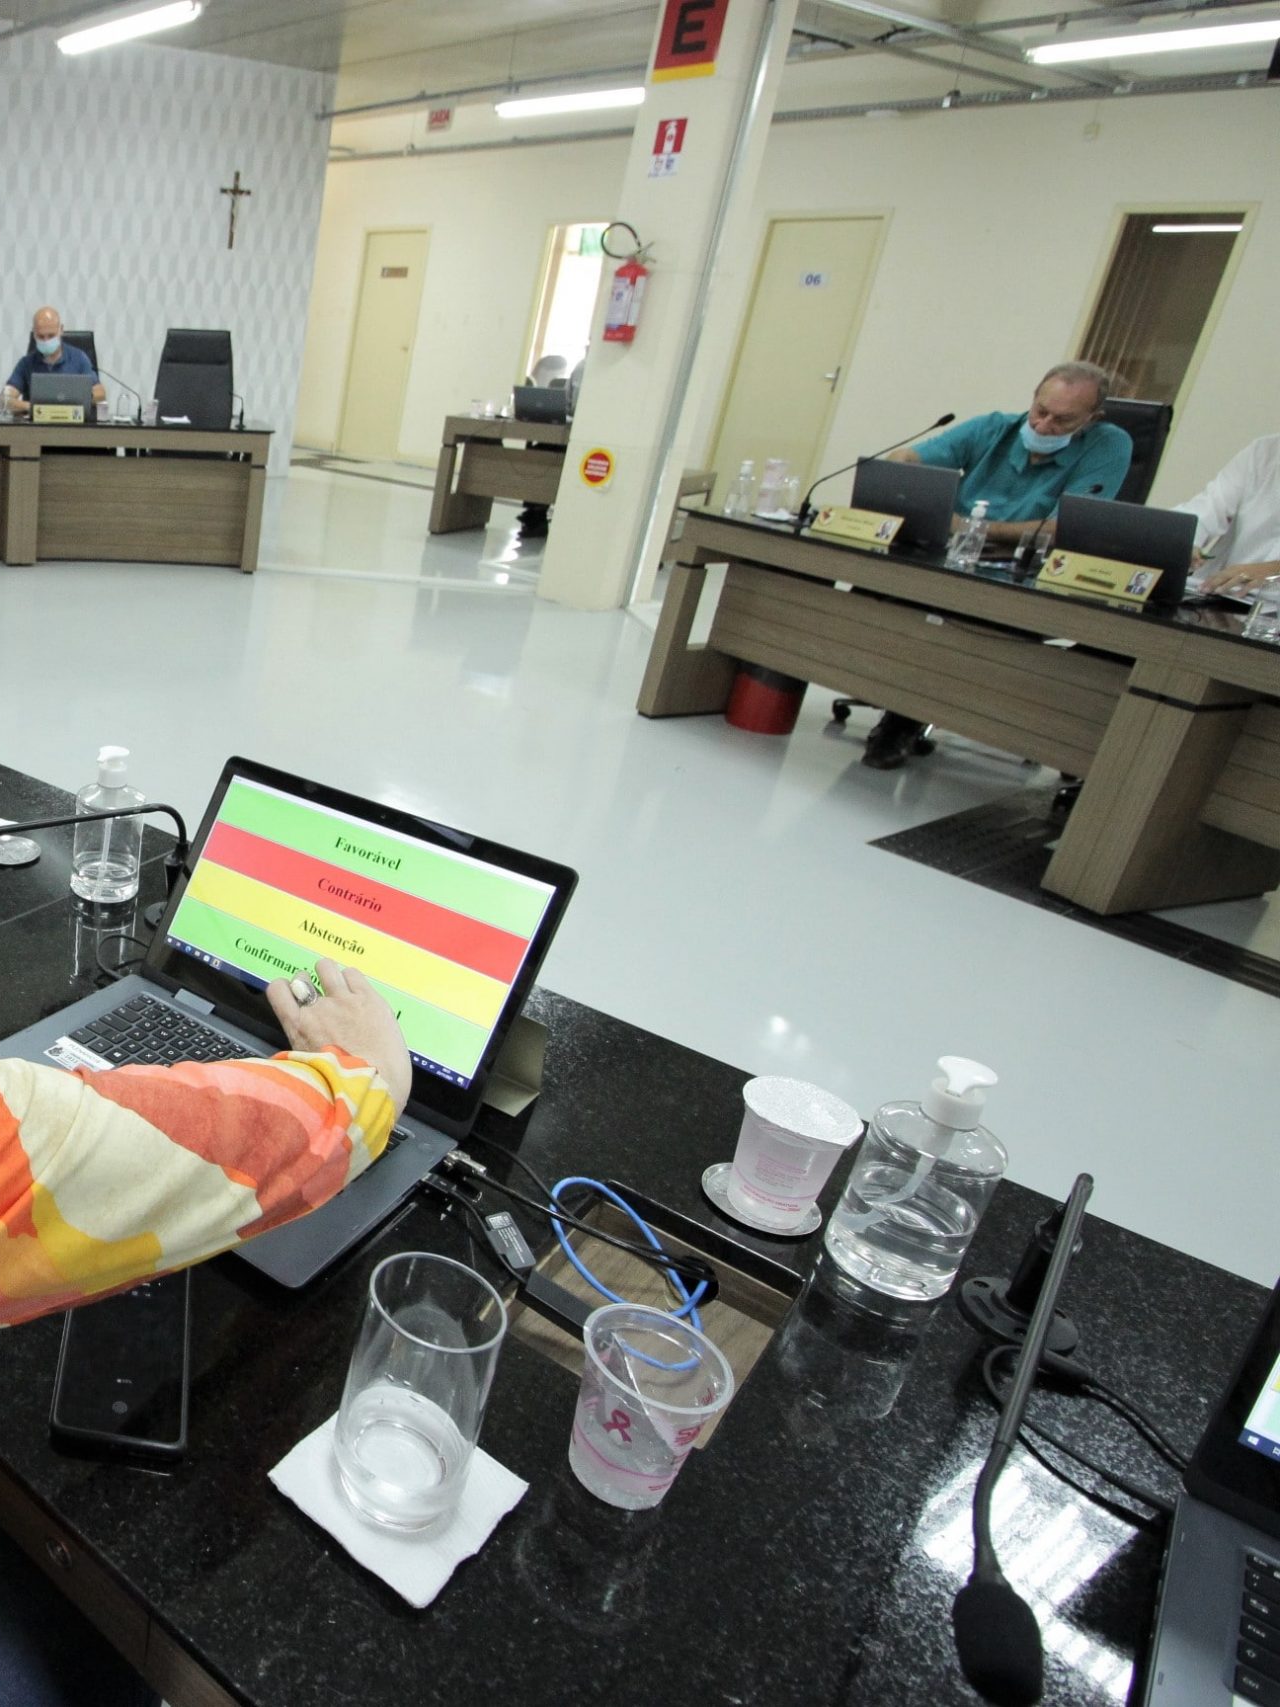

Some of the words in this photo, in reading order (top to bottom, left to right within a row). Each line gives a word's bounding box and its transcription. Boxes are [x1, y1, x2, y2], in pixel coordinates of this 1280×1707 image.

[671, 0, 716, 54] E
[805, 273, 821, 286] 06
[334, 836, 402, 871] Favorável
[317, 877, 383, 913] Contrário
[234, 937, 300, 974] Confirmar
[298, 919, 366, 956] Abstenção
